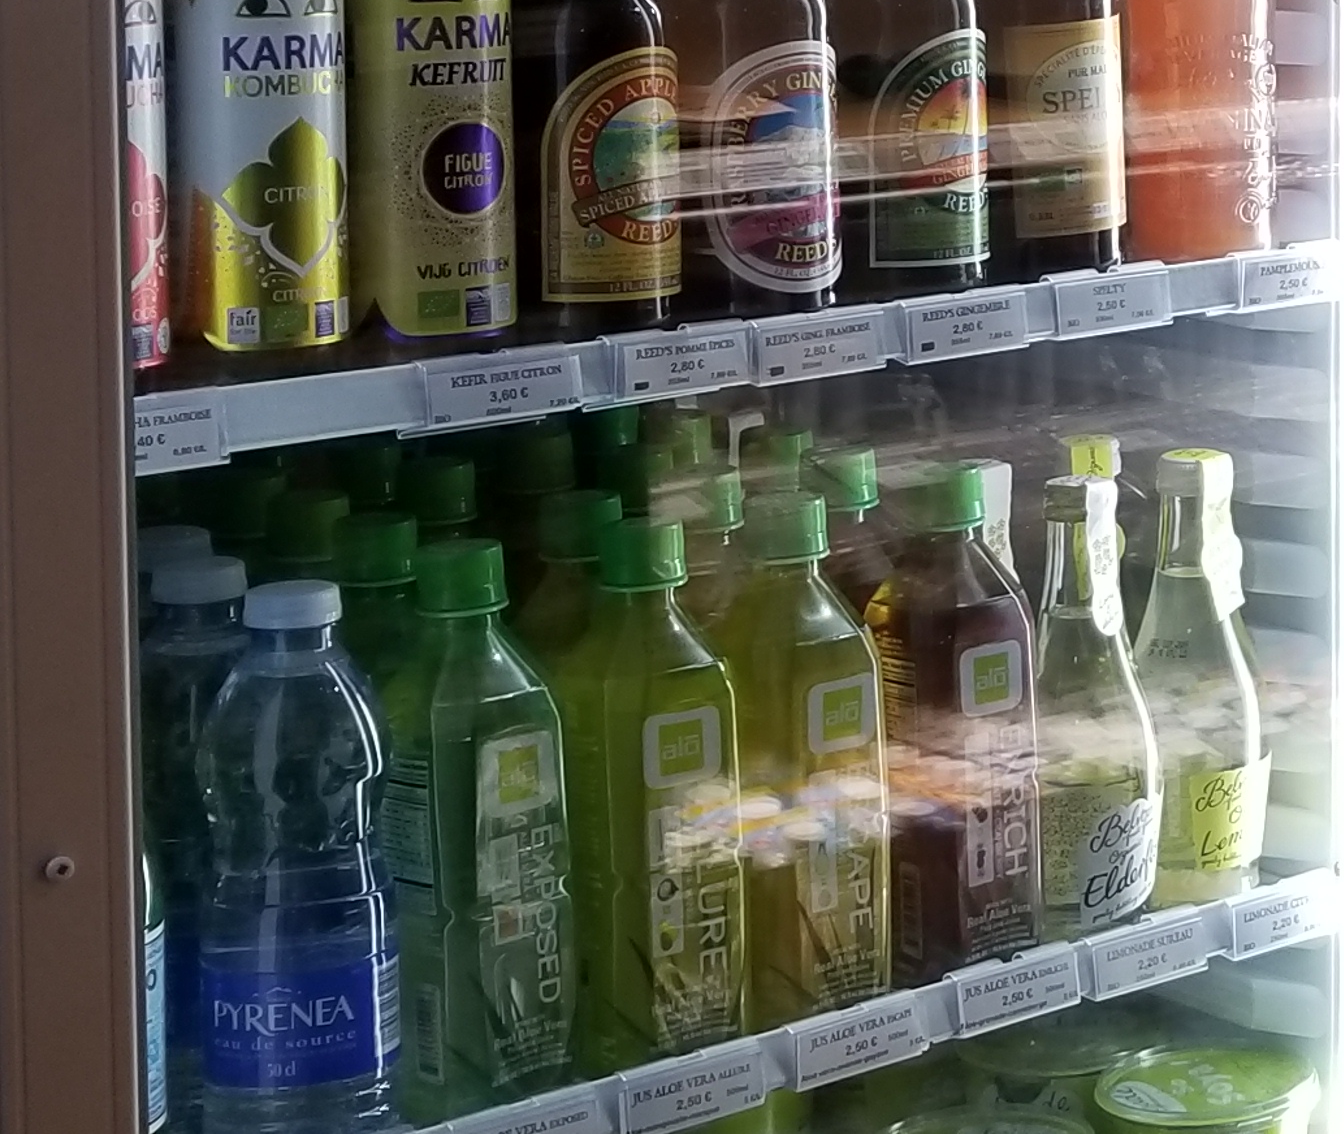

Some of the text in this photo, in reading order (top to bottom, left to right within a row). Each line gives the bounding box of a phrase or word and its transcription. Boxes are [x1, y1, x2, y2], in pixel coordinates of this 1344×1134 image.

[395, 13, 510, 52] KARMA
[221, 34, 344, 71] KARMA
[409, 57, 507, 87] KEFRUIT
[1067, 66, 1088, 79] PUR
[902, 66, 950, 163] PREMIUM
[572, 99, 614, 186] SPICED
[444, 152, 493, 173] FIGUE
[444, 173, 492, 190] CITRON
[580, 195, 635, 222] SPICED
[417, 263, 452, 280] VIJG
[1093, 283, 1127, 296] SPELTY
[1279, 279, 1298, 290] 2,50
[1097, 300, 1117, 311] 2,50
[230, 310, 256, 327] fair
[922, 308, 955, 323] REED'S
[765, 322, 871, 348] REED'S FRAMBOISE
[952, 323, 974, 335] 2,80
[635, 345, 672, 360] REED'S
[803, 345, 826, 357] 2,80
[670, 360, 695, 372] 2,80
[451, 364, 563, 389] KEFIR FIGUE CITRON
[489, 388, 518, 403] 3,60
[1001, 726, 1029, 879] ENRICH
[526, 823, 564, 1004] EXPOSED
[1011, 903, 1032, 918] Vera
[1243, 900, 1289, 923] LIMONADE
[1272, 917, 1292, 931] 2,20
[1106, 928, 1193, 962] LIMONADE SUREAU
[1138, 955, 1159, 970] 2,20
[964, 970, 1038, 1001] JUS ALOE VERA
[214, 1030, 356, 1050] eau de source
[810, 1017, 886, 1052] JUS ALOE VERA
[631, 1072, 717, 1108] JUS ALOE VERA
[676, 1096, 702, 1111] 2,50
[550, 1111, 588, 1130] EXPOSED
